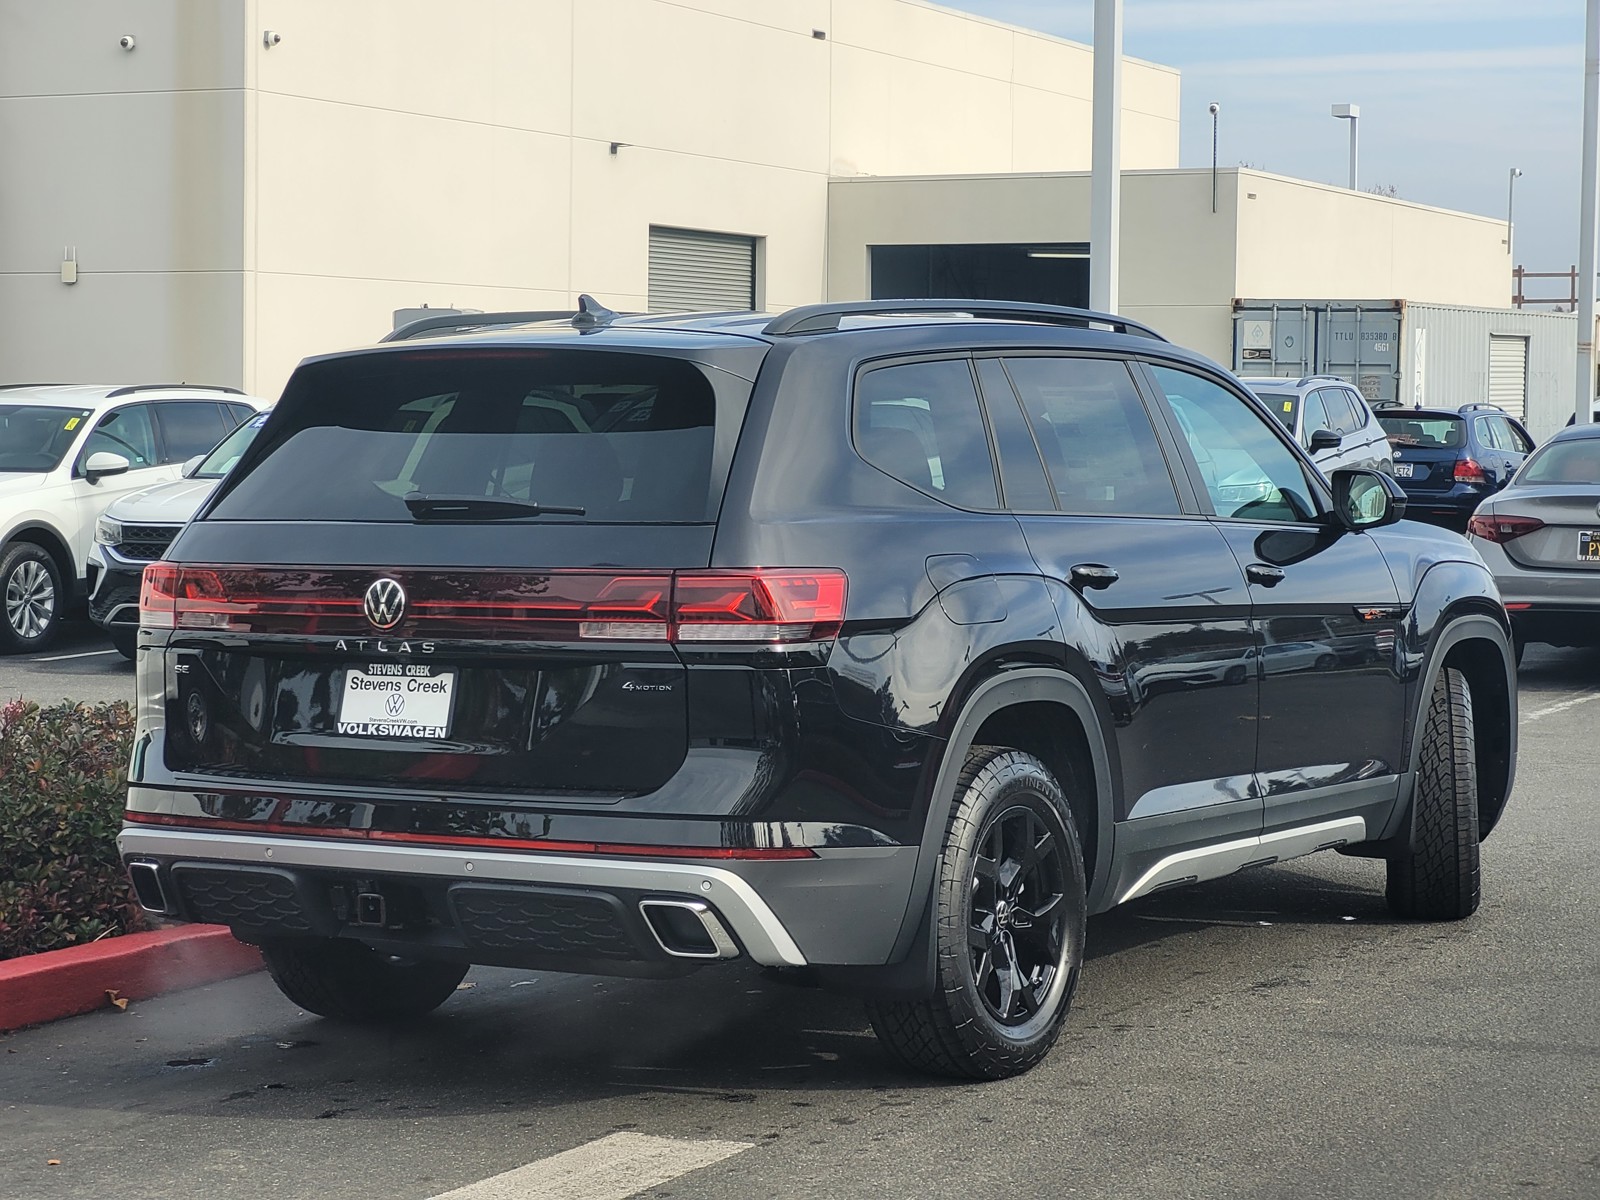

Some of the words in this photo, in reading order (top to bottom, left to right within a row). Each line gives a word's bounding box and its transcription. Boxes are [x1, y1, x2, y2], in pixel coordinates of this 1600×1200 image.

[1335, 332, 1354, 341] TTLU
[1374, 342, 1389, 352] 45G1
[334, 640, 435, 653] ATLAS
[174, 665, 190, 674] SE
[368, 663, 402, 675] STEVENS
[405, 665, 431, 676] CREEK
[350, 676, 402, 692] Stevens
[407, 678, 448, 693] Creek
[621, 681, 672, 691] 4MOTION
[337, 722, 447, 738] VOLKSWAGEN
